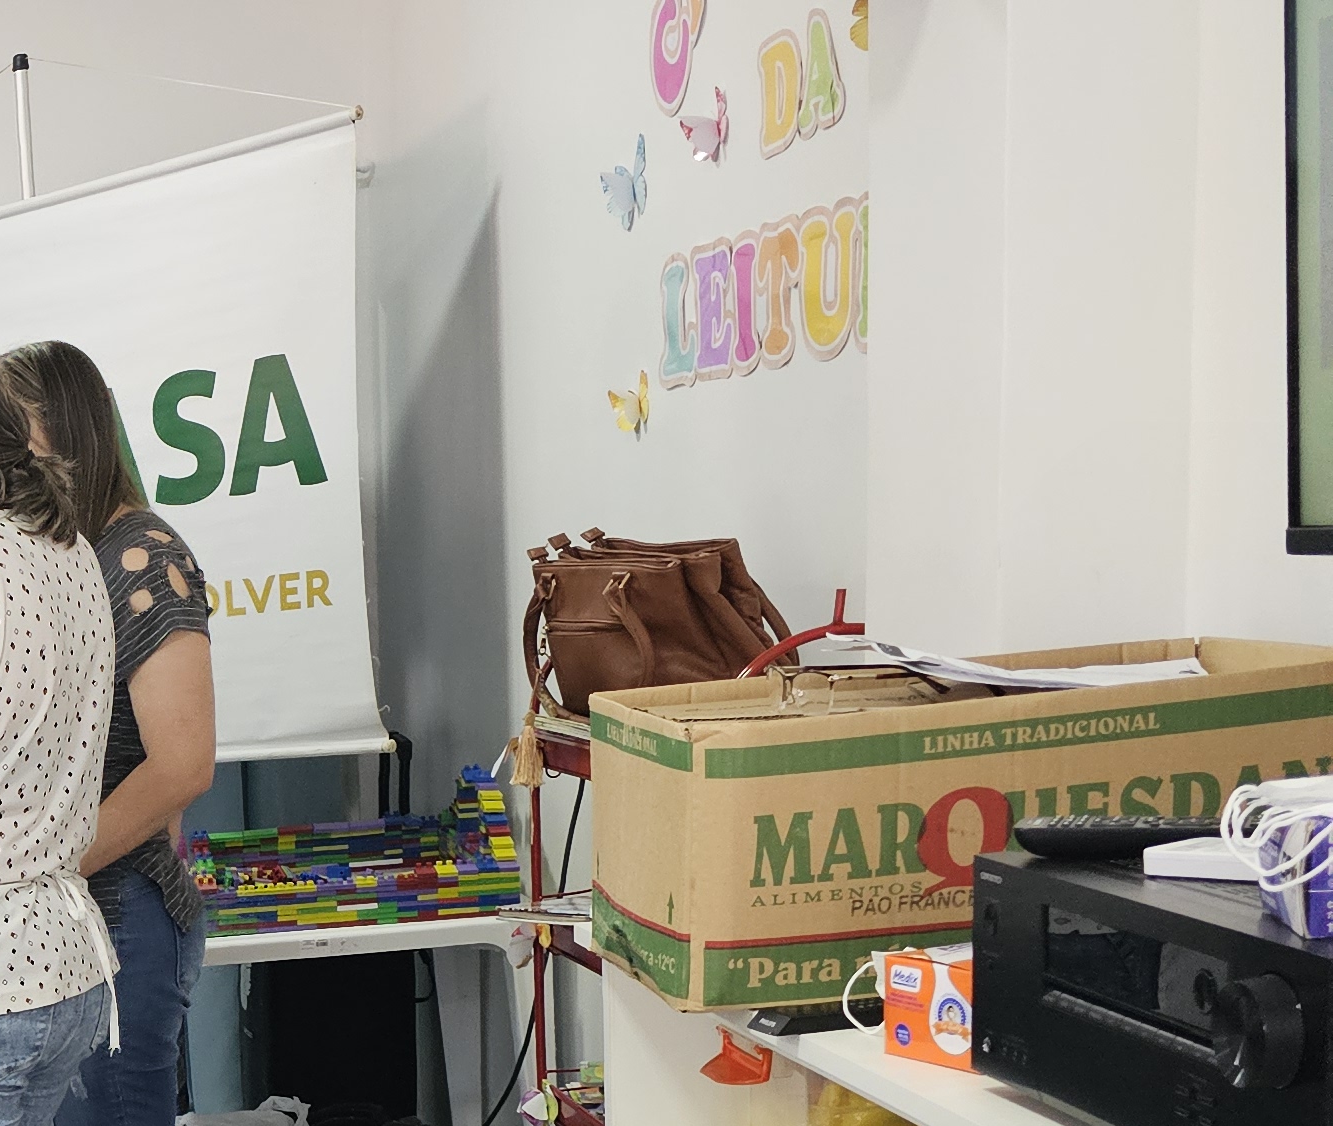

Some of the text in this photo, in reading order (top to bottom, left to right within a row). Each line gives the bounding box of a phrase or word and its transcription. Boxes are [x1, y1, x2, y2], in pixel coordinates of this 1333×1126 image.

[758, 12, 844, 158] DA
[110, 353, 328, 506] SA
[923, 712, 1160, 754] LINHA TRADICIONAL
[750, 755, 1332, 897] MARQUES
[751, 880, 923, 908] ALIMENTOS
